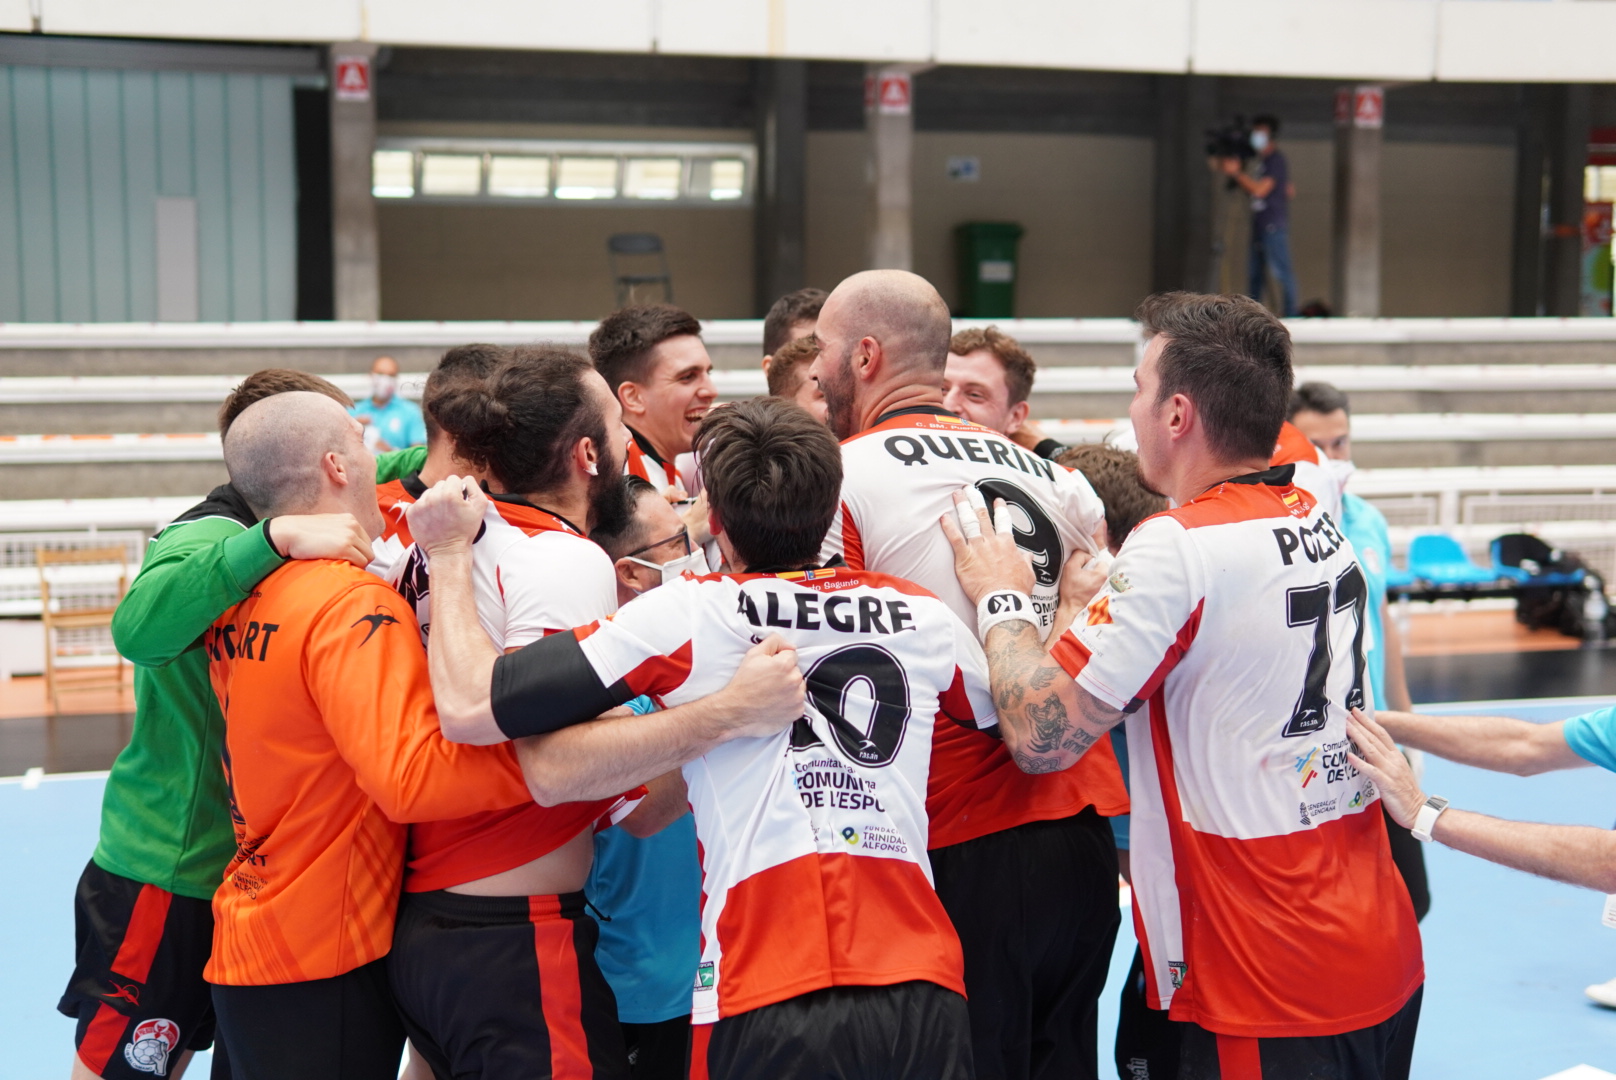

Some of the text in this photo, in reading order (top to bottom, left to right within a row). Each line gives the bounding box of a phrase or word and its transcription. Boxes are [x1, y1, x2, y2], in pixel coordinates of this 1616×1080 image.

[884, 434, 1057, 483] QUERÍN
[973, 477, 1064, 587] 9
[824, 579, 859, 589] Sagunto
[737, 589, 916, 634] ALEGRE
[1282, 561, 1368, 738] 77
[784, 640, 912, 769] 0
[801, 791, 825, 808] DE
[862, 841, 908, 854] ALFONSO
